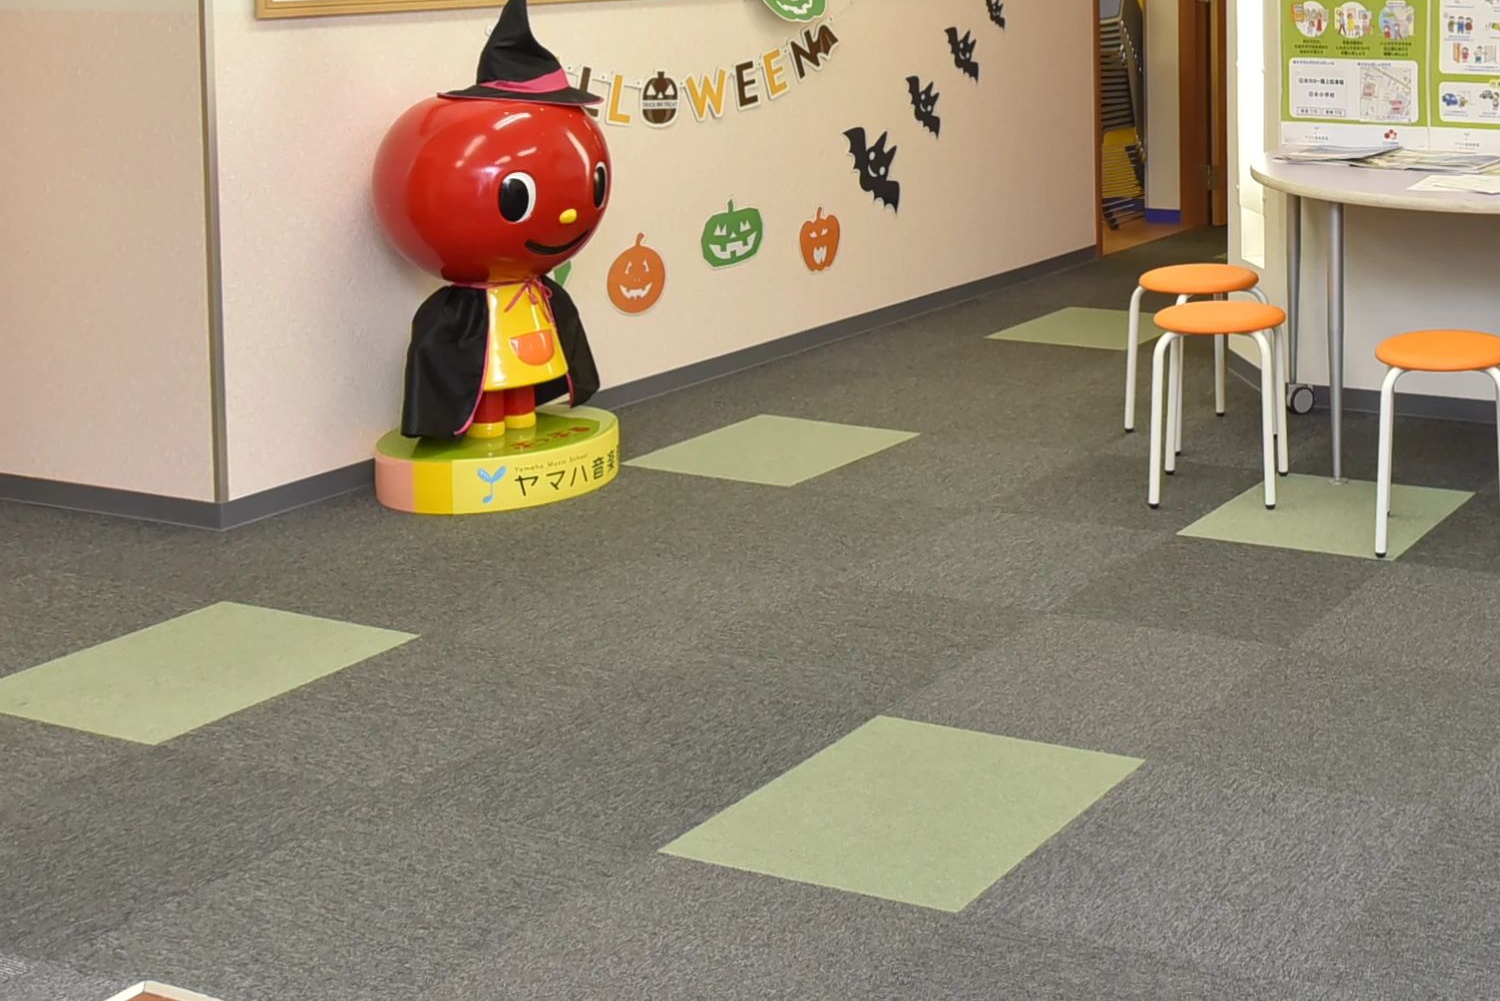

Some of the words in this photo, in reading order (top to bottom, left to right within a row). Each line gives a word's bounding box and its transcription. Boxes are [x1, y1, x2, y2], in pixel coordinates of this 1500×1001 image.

[515, 444, 619, 496] ヤマハ音楽
